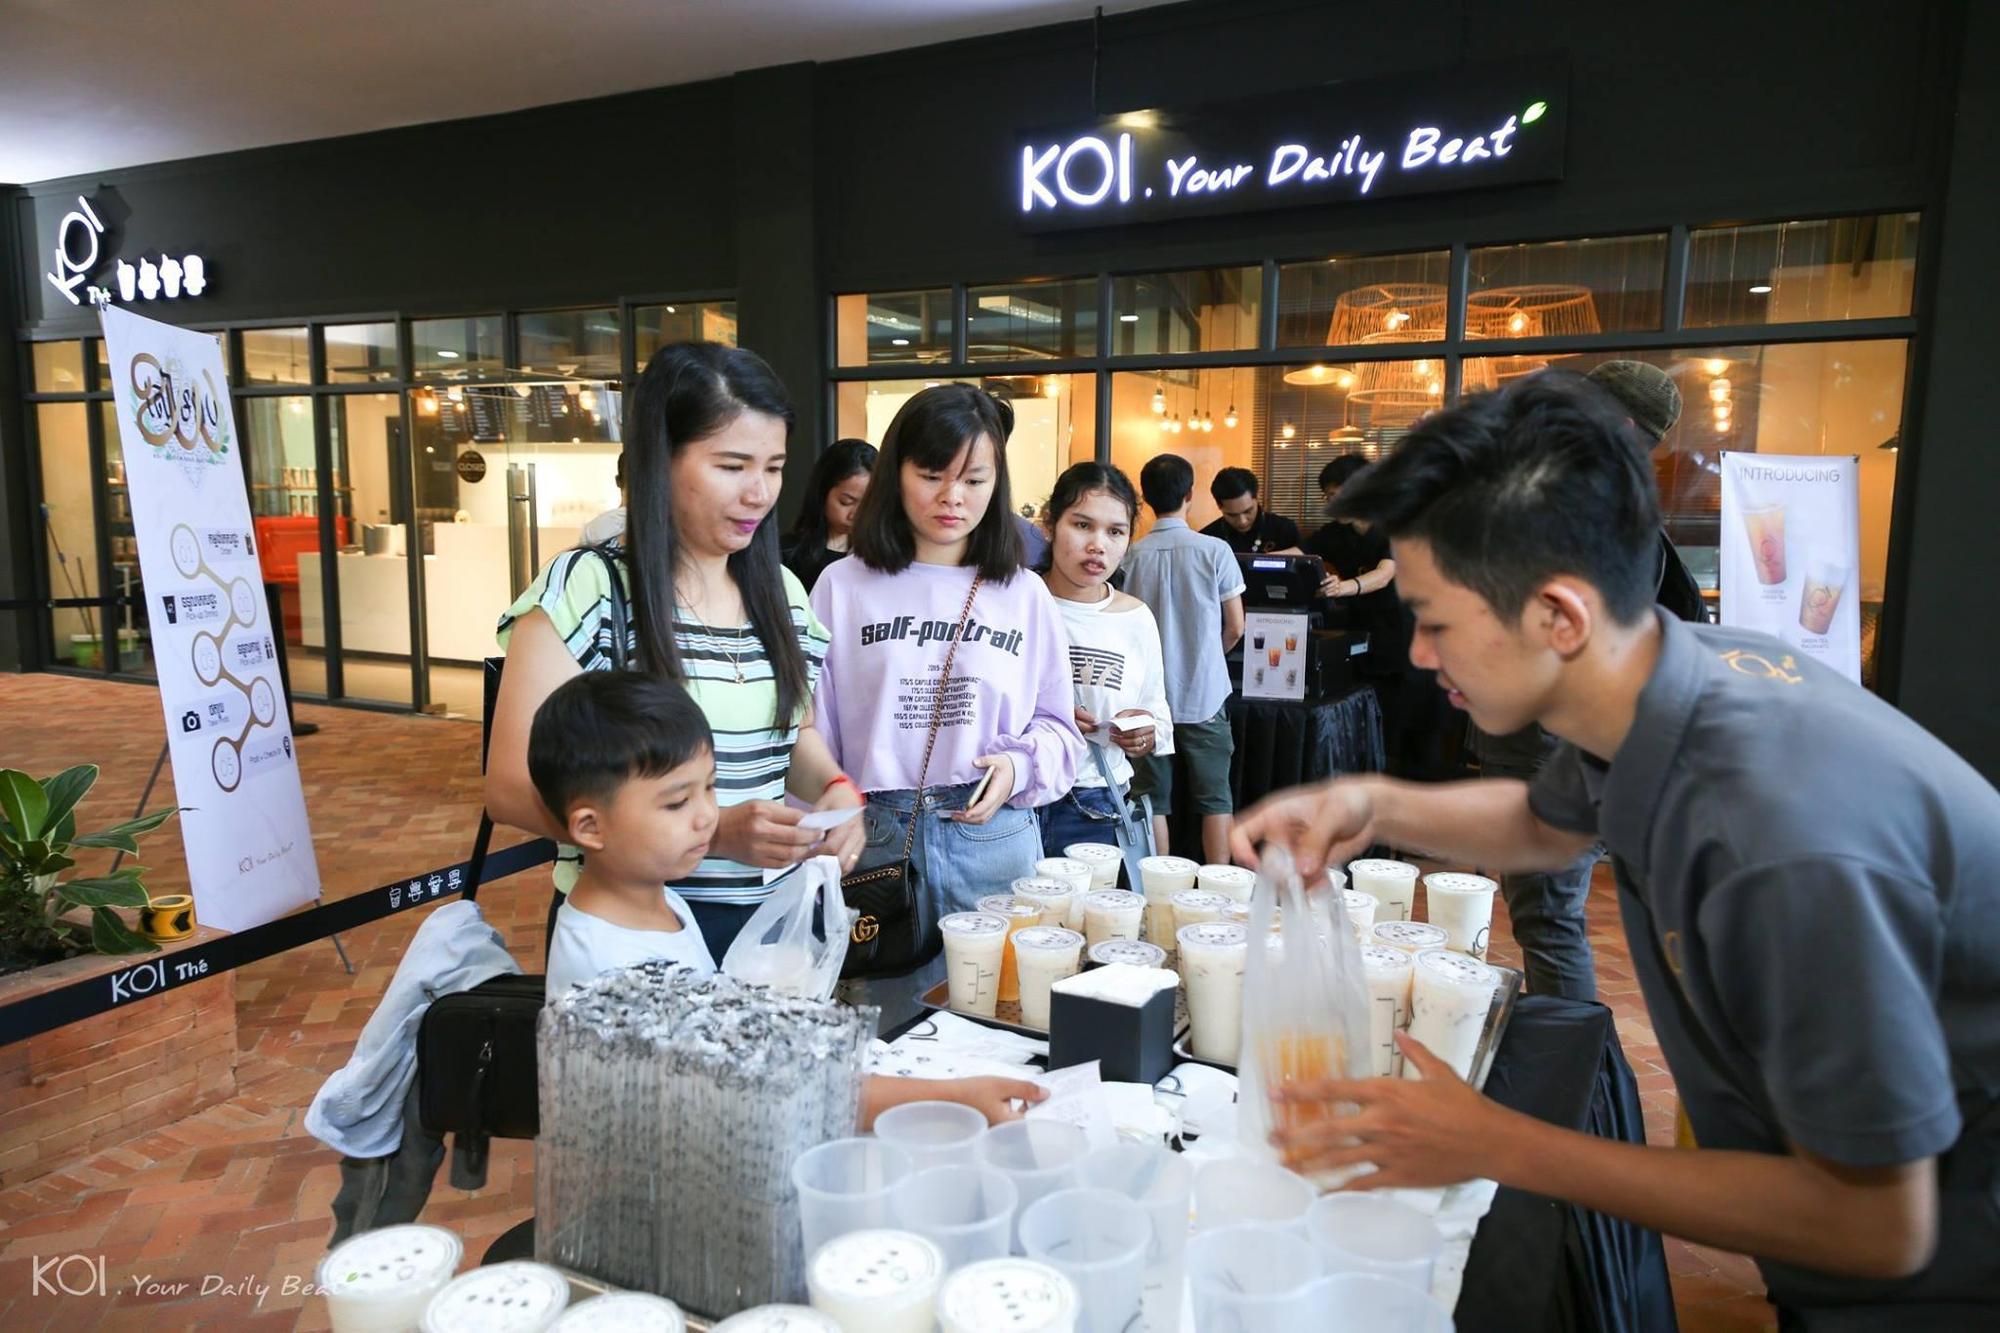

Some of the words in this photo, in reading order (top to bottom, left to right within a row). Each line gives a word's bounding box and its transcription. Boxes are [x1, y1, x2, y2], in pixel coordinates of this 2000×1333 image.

[1167, 155, 1254, 198] Your
[1268, 133, 1385, 194] Daily
[1402, 114, 1518, 170] Beat
[47, 195, 105, 305] KOI
[1739, 466, 1841, 482] INTRODUCING
[111, 959, 166, 1003] KOI
[174, 959, 209, 980] Thé
